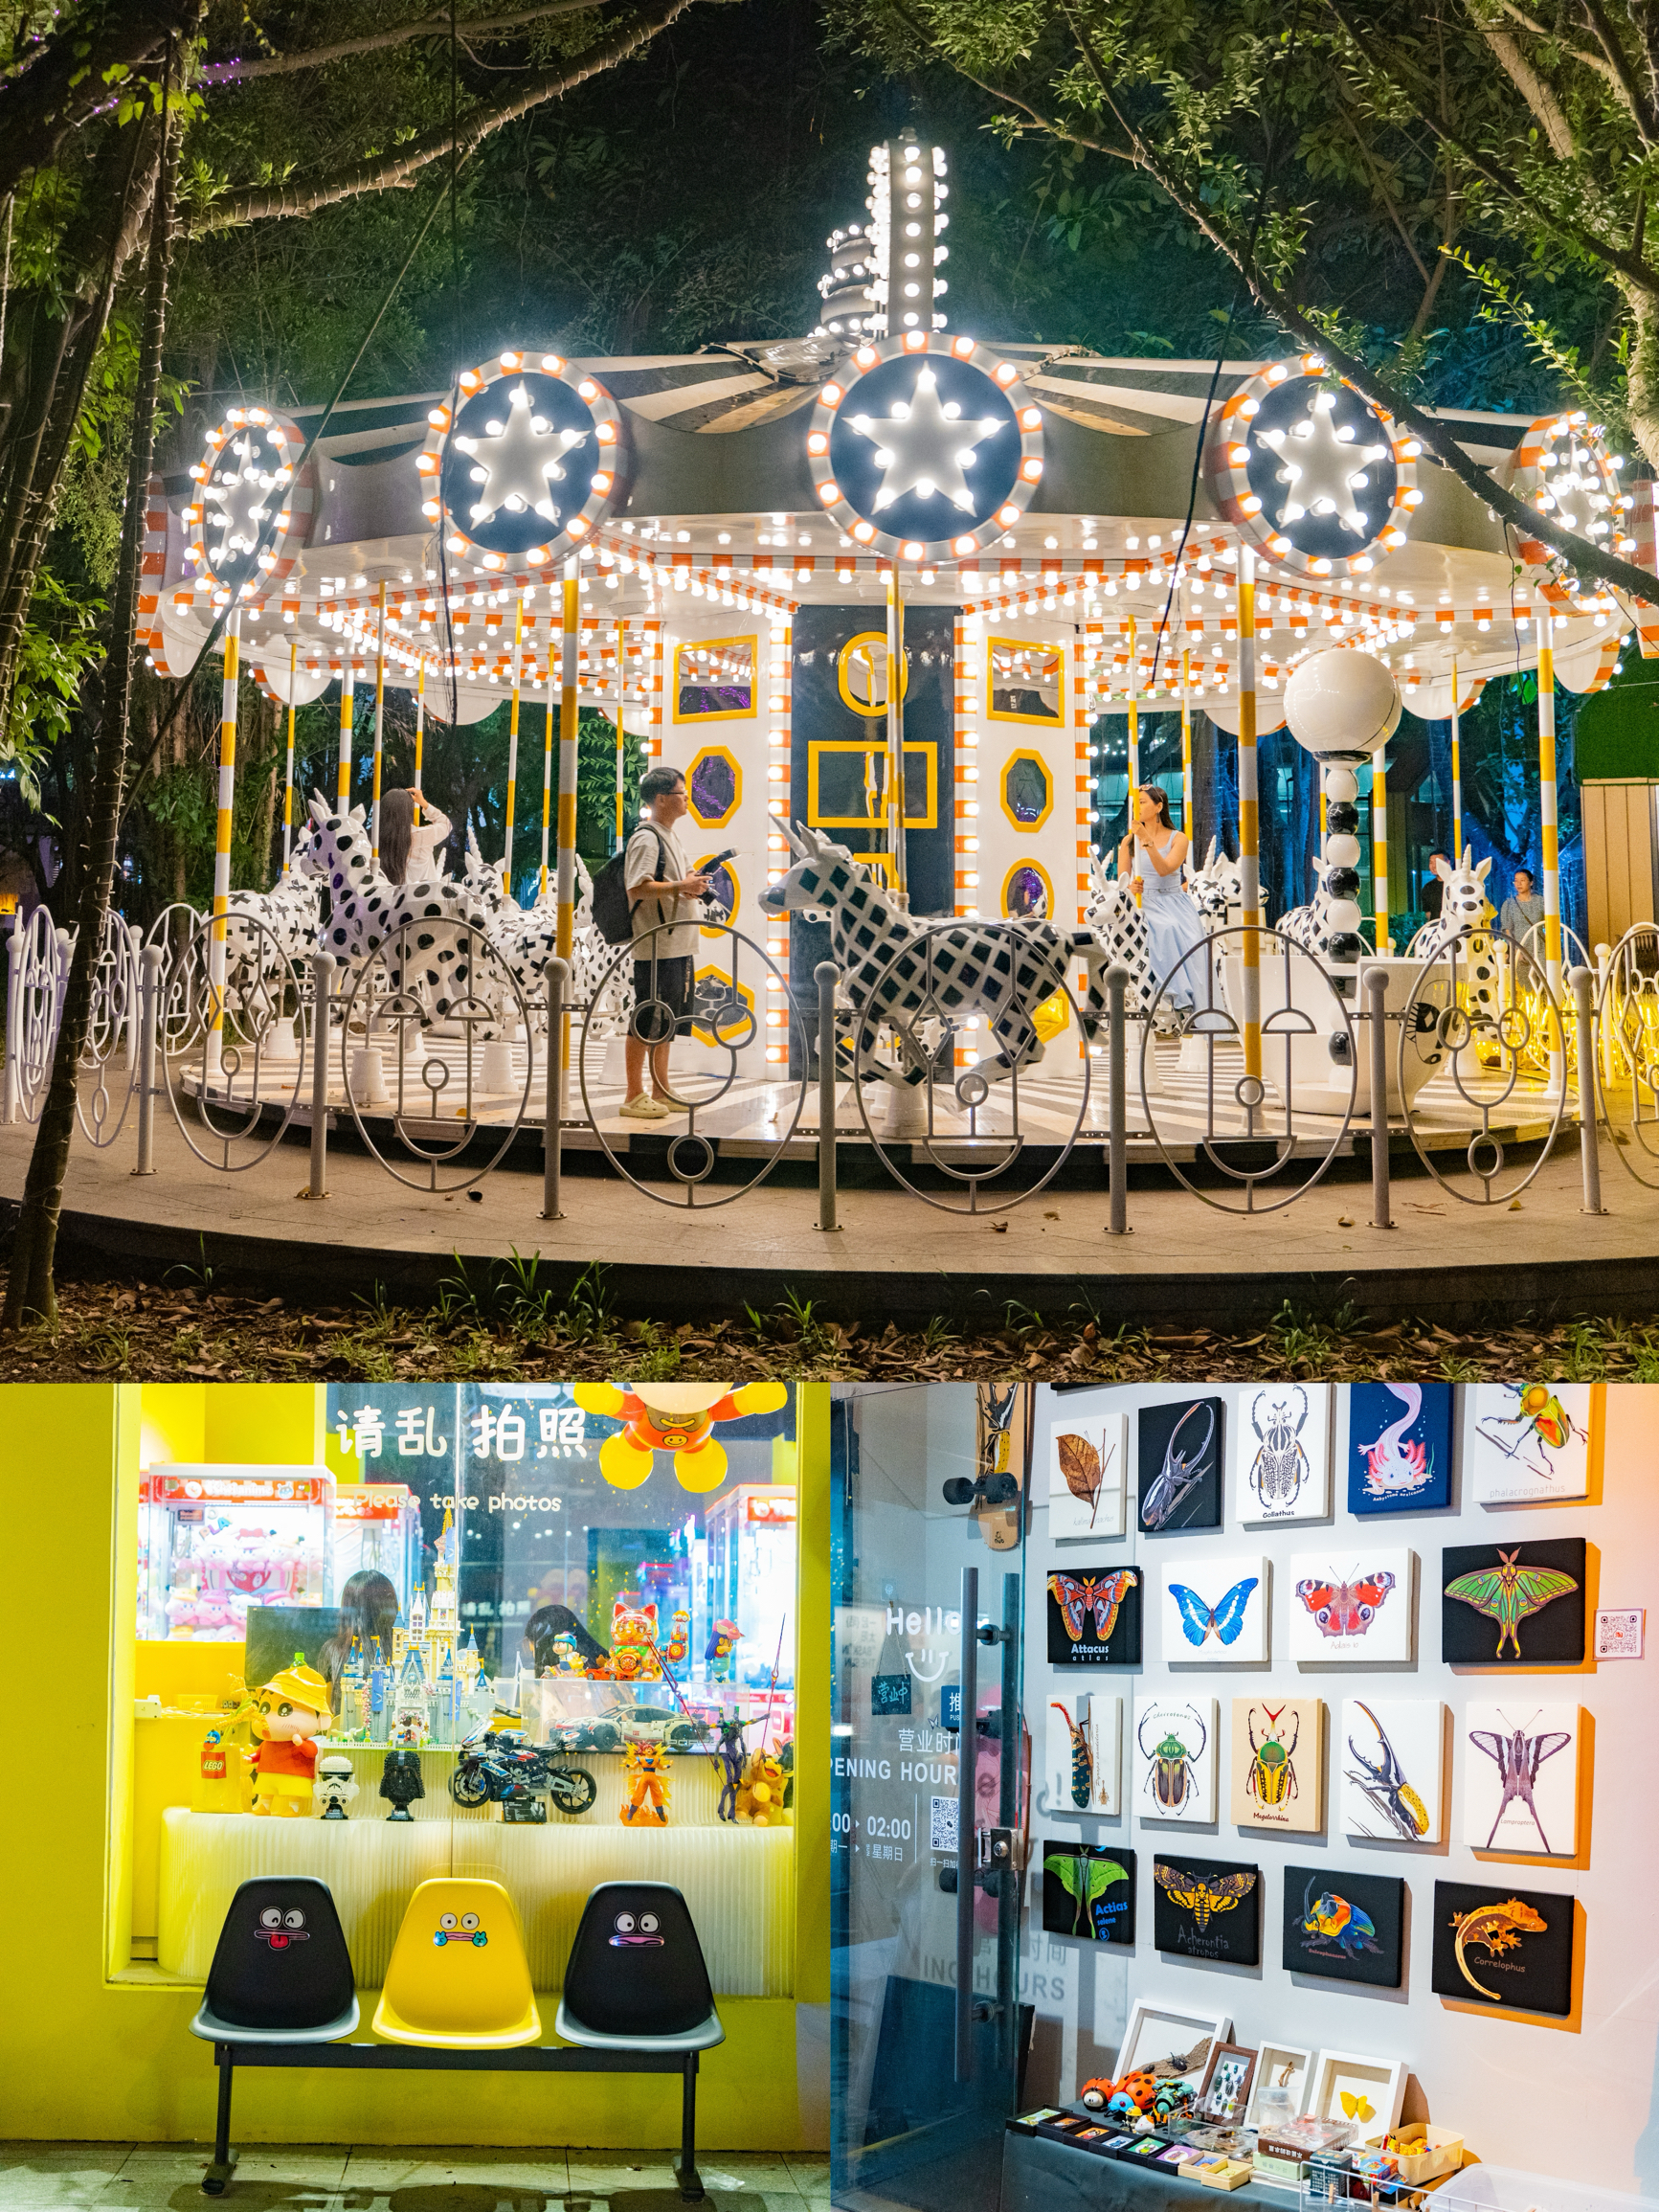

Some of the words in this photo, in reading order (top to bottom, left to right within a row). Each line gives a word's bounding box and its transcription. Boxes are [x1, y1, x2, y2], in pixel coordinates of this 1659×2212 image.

[336, 1405, 588, 1460] 请乱拍照
[1490, 1484, 1565, 1499] phalacrognathus
[354, 1489, 420, 1509] Please
[430, 1492, 479, 1510] take
[488, 1492, 562, 1513] photos
[1262, 1510, 1295, 1519] Goliathus
[886, 1606, 961, 1636] Hello
[1070, 1643, 1110, 1655] Attacus
[878, 1681, 908, 1704] 营业中
[203, 1760, 224, 1771] LEGO
[830, 1758, 890, 1780] ENING
[901, 1761, 957, 1786] HOUR
[867, 1816, 910, 1840] 02:00
[872, 1843, 903, 1862] 星期日
[930, 1858, 958, 1868] 扫一扫加
[1095, 1901, 1129, 1916] Actias
[1177, 1925, 1229, 1950] Acherontia
[1187, 1946, 1219, 1959] atropos
[1474, 1956, 1526, 1973] Correlophus
